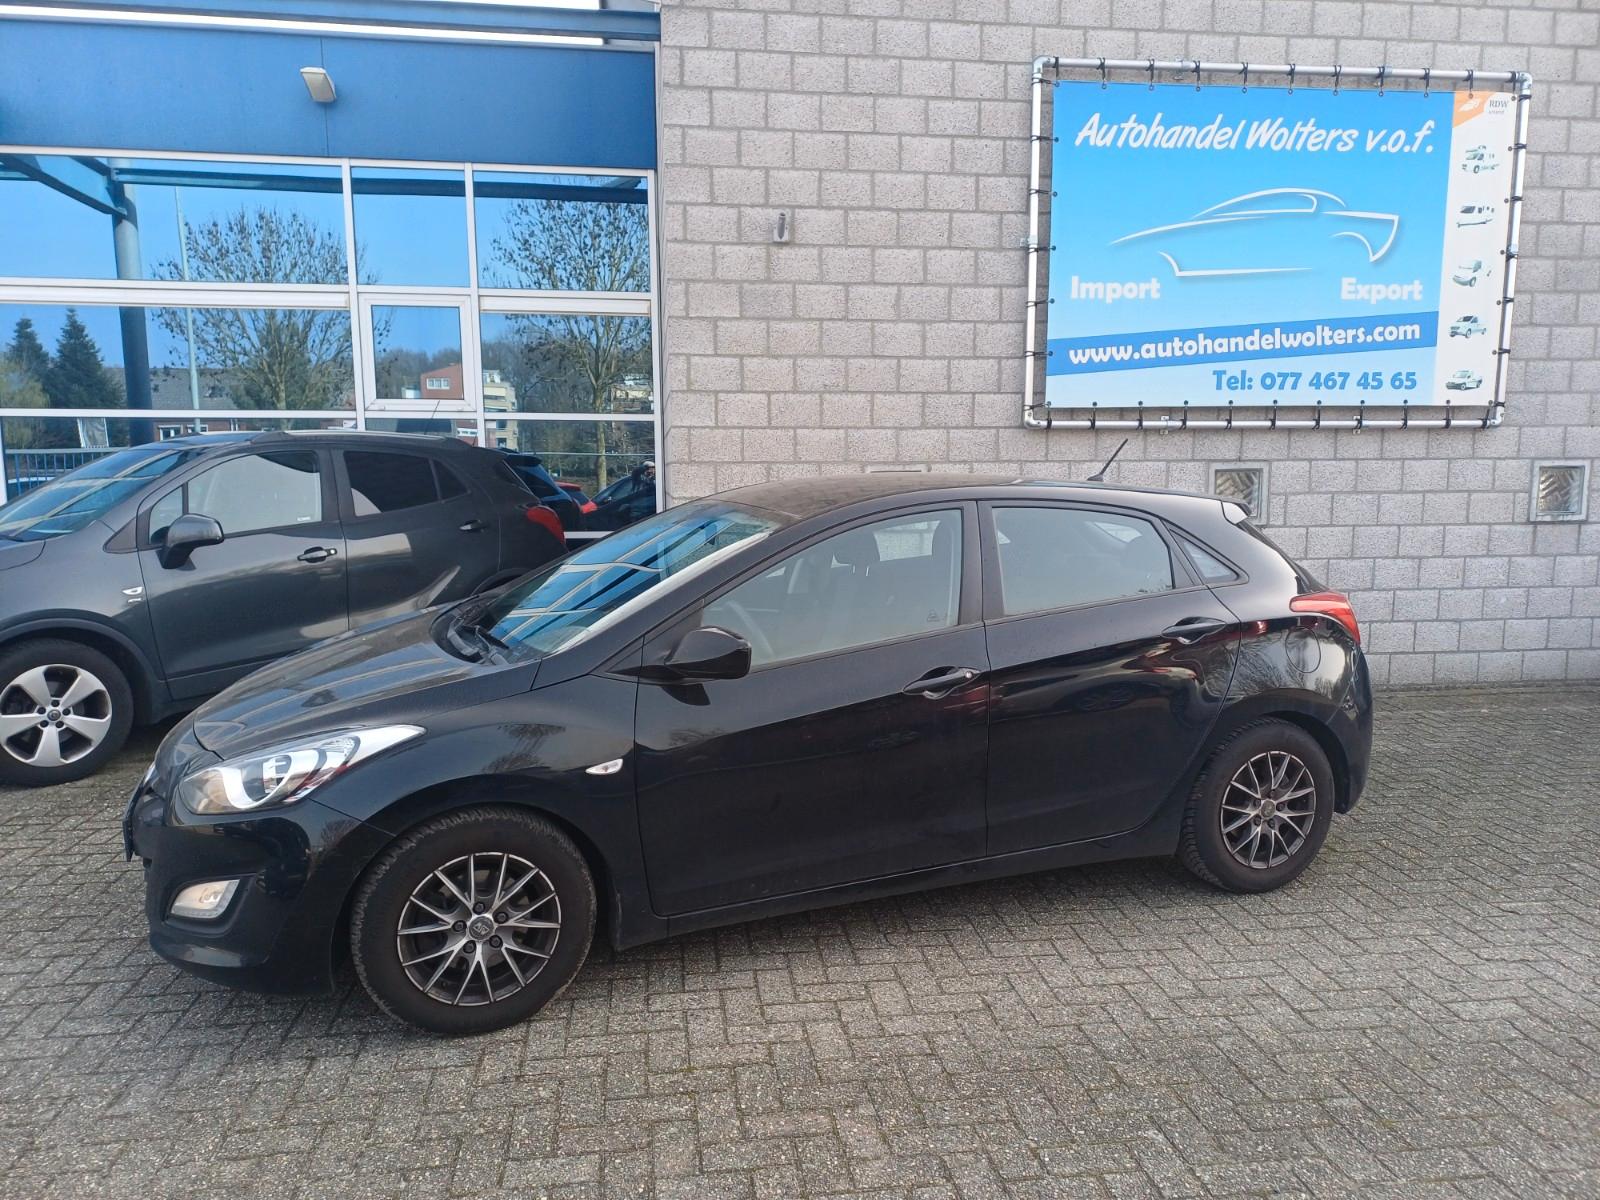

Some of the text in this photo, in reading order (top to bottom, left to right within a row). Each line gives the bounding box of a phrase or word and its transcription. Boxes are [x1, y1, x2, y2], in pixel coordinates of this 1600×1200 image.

[1074, 112, 1435, 153] Autohandel Wolters v.o.f.
[1070, 275, 1161, 304] Import
[1340, 277, 1424, 304] Export
[1068, 323, 1421, 365] www.autohandelwolters.com
[1212, 369, 1417, 391] Tel: 077 467 45 65
